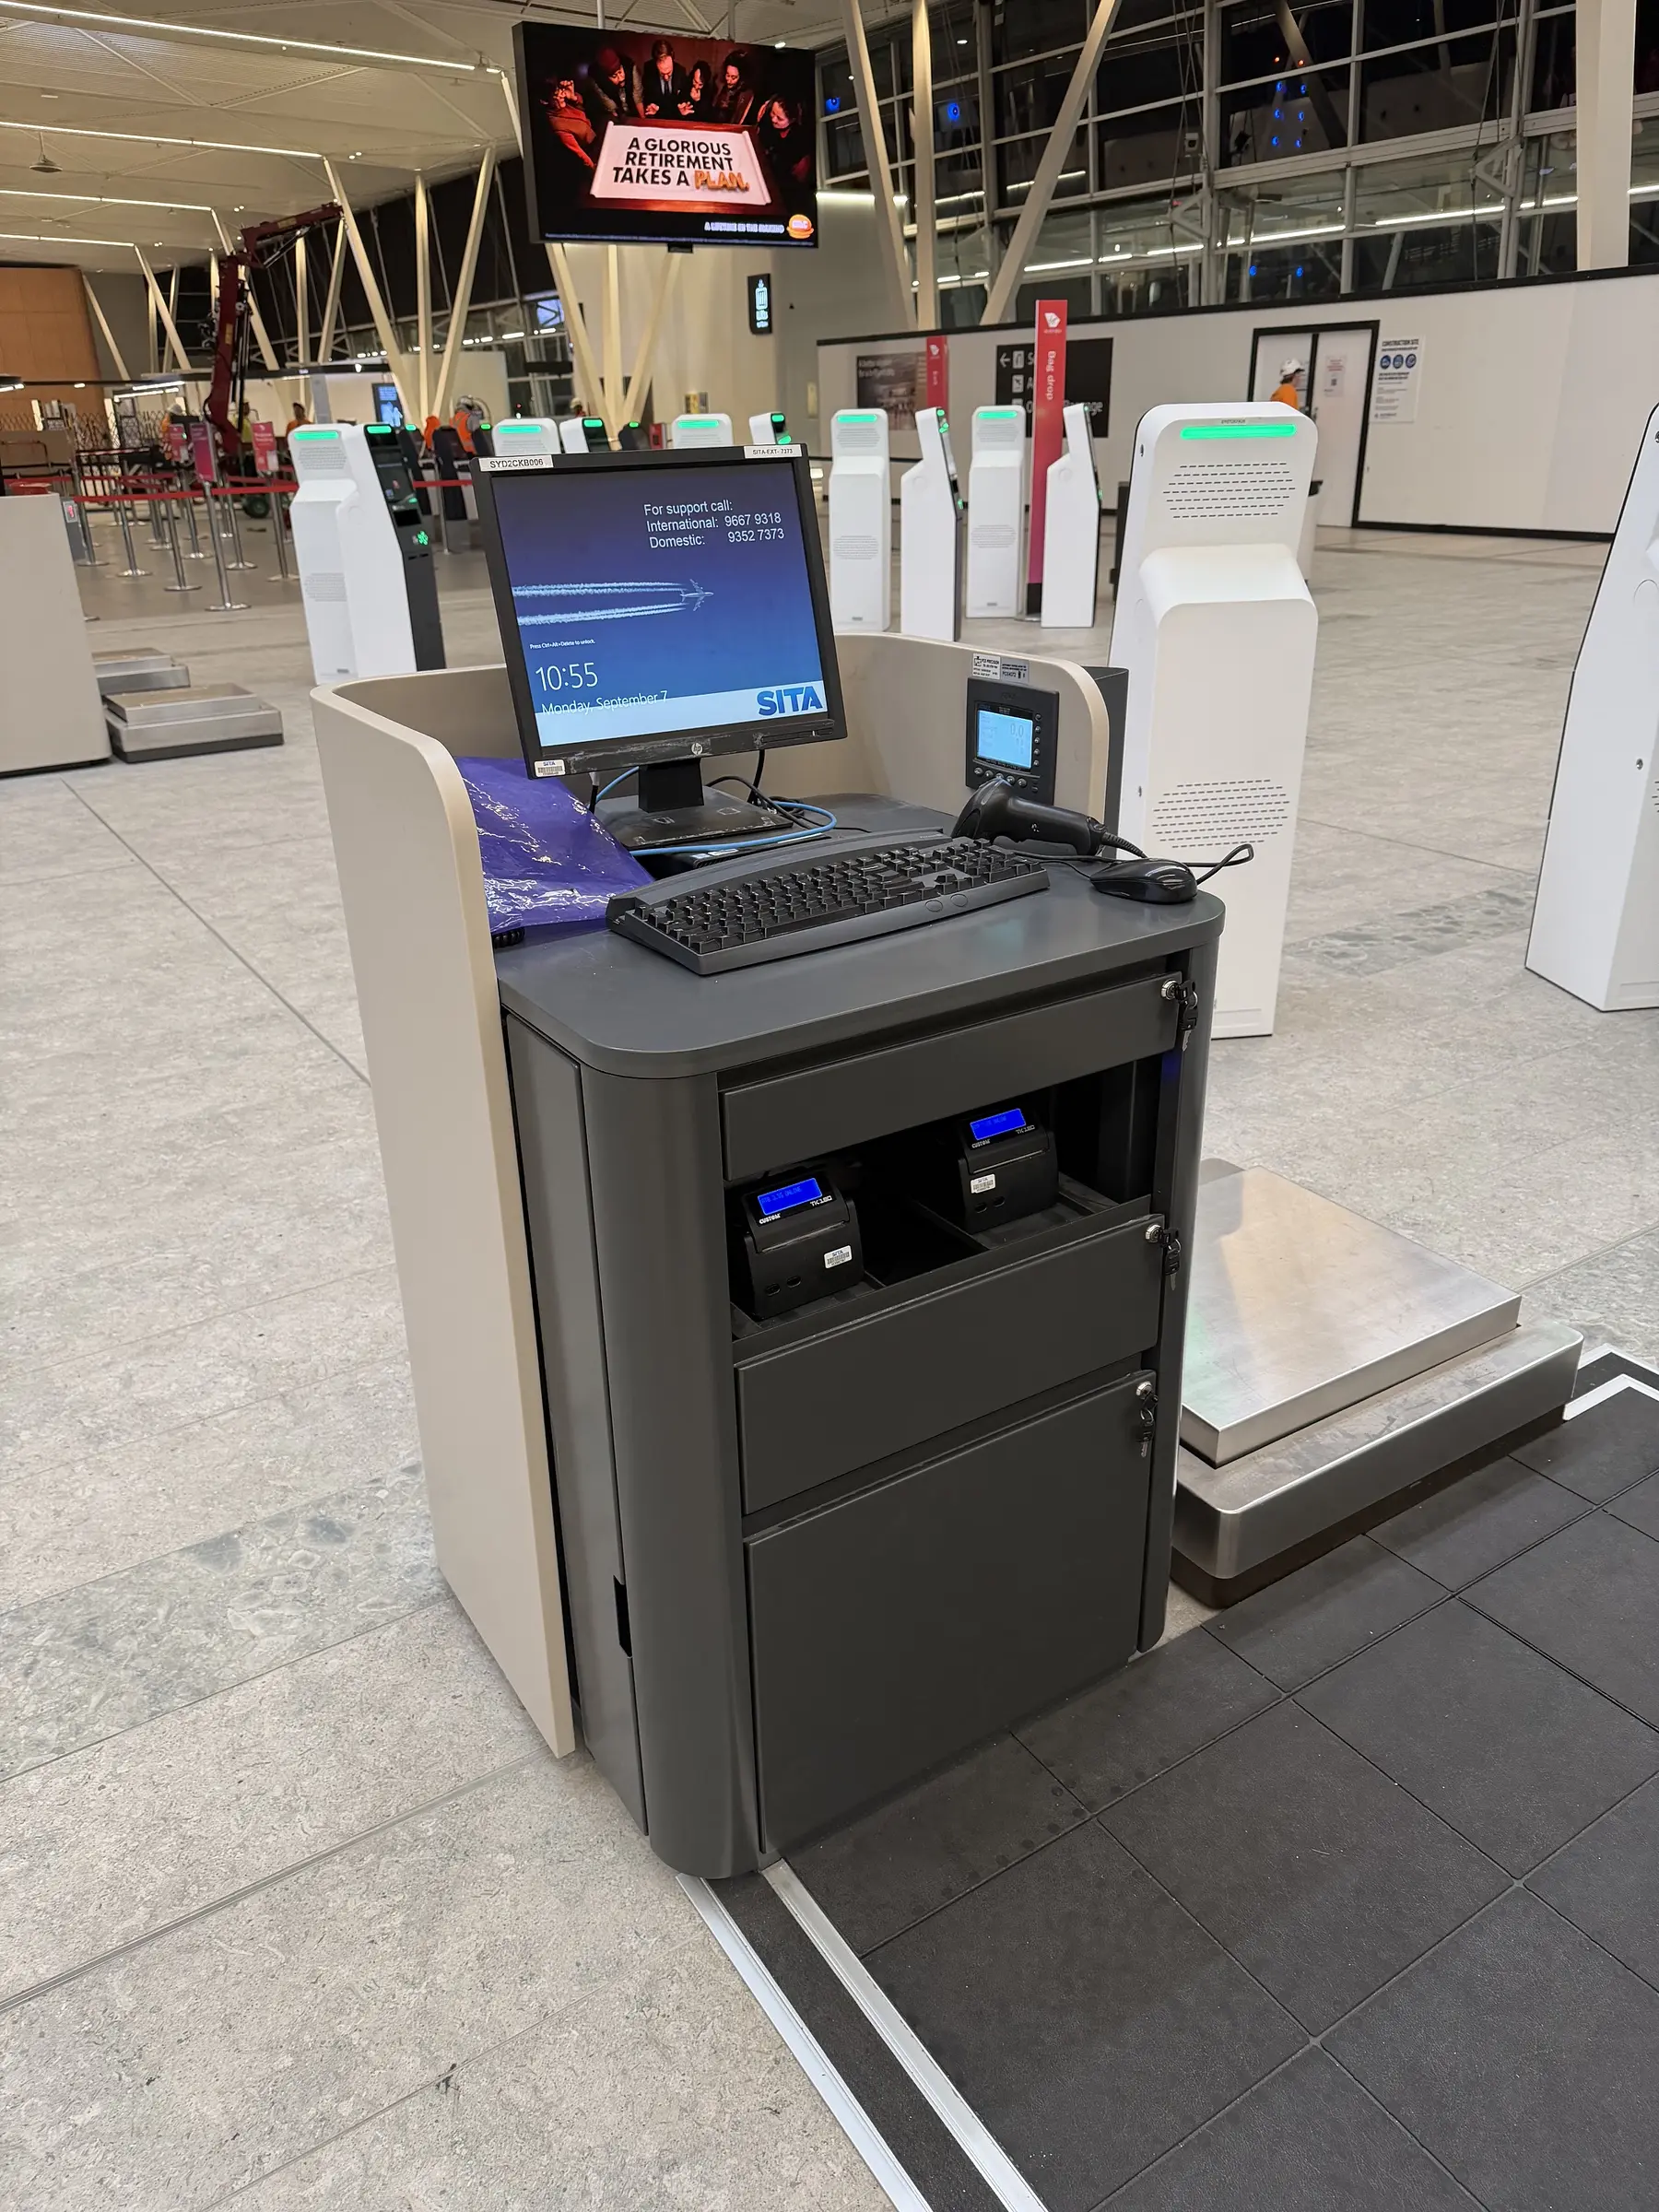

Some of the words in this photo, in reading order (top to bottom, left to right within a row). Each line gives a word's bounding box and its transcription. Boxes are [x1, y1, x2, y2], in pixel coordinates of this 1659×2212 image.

[628, 137, 641, 150] A
[644, 138, 731, 156] GLORIOUS
[625, 151, 734, 171] RETIREMENT
[613, 167, 671, 185] TAKES
[677, 171, 690, 186] A
[694, 170, 750, 192] PLAN.
[1046, 350, 1056, 372] Bag
[1045, 374, 1055, 400] drop
[489, 458, 544, 468] SYD2CKB006
[643, 503, 663, 515] For
[666, 500, 709, 516] support
[711, 500, 734, 512] call:
[646, 516, 719, 532] International:
[724, 514, 751, 527] 9667
[754, 512, 782, 524] 9318
[650, 535, 705, 548] Domestic:
[727, 530, 755, 543] 9352
[757, 528, 784, 540] 7373
[535, 662, 598, 691] 10:55
[541, 700, 594, 716] Monday,
[595, 692, 658, 712] September
[660, 689, 668, 702] 7
[757, 686, 823, 716] SITA
[692, 743, 702, 755] hp
[759, 1212, 782, 1225] CUSTOM
